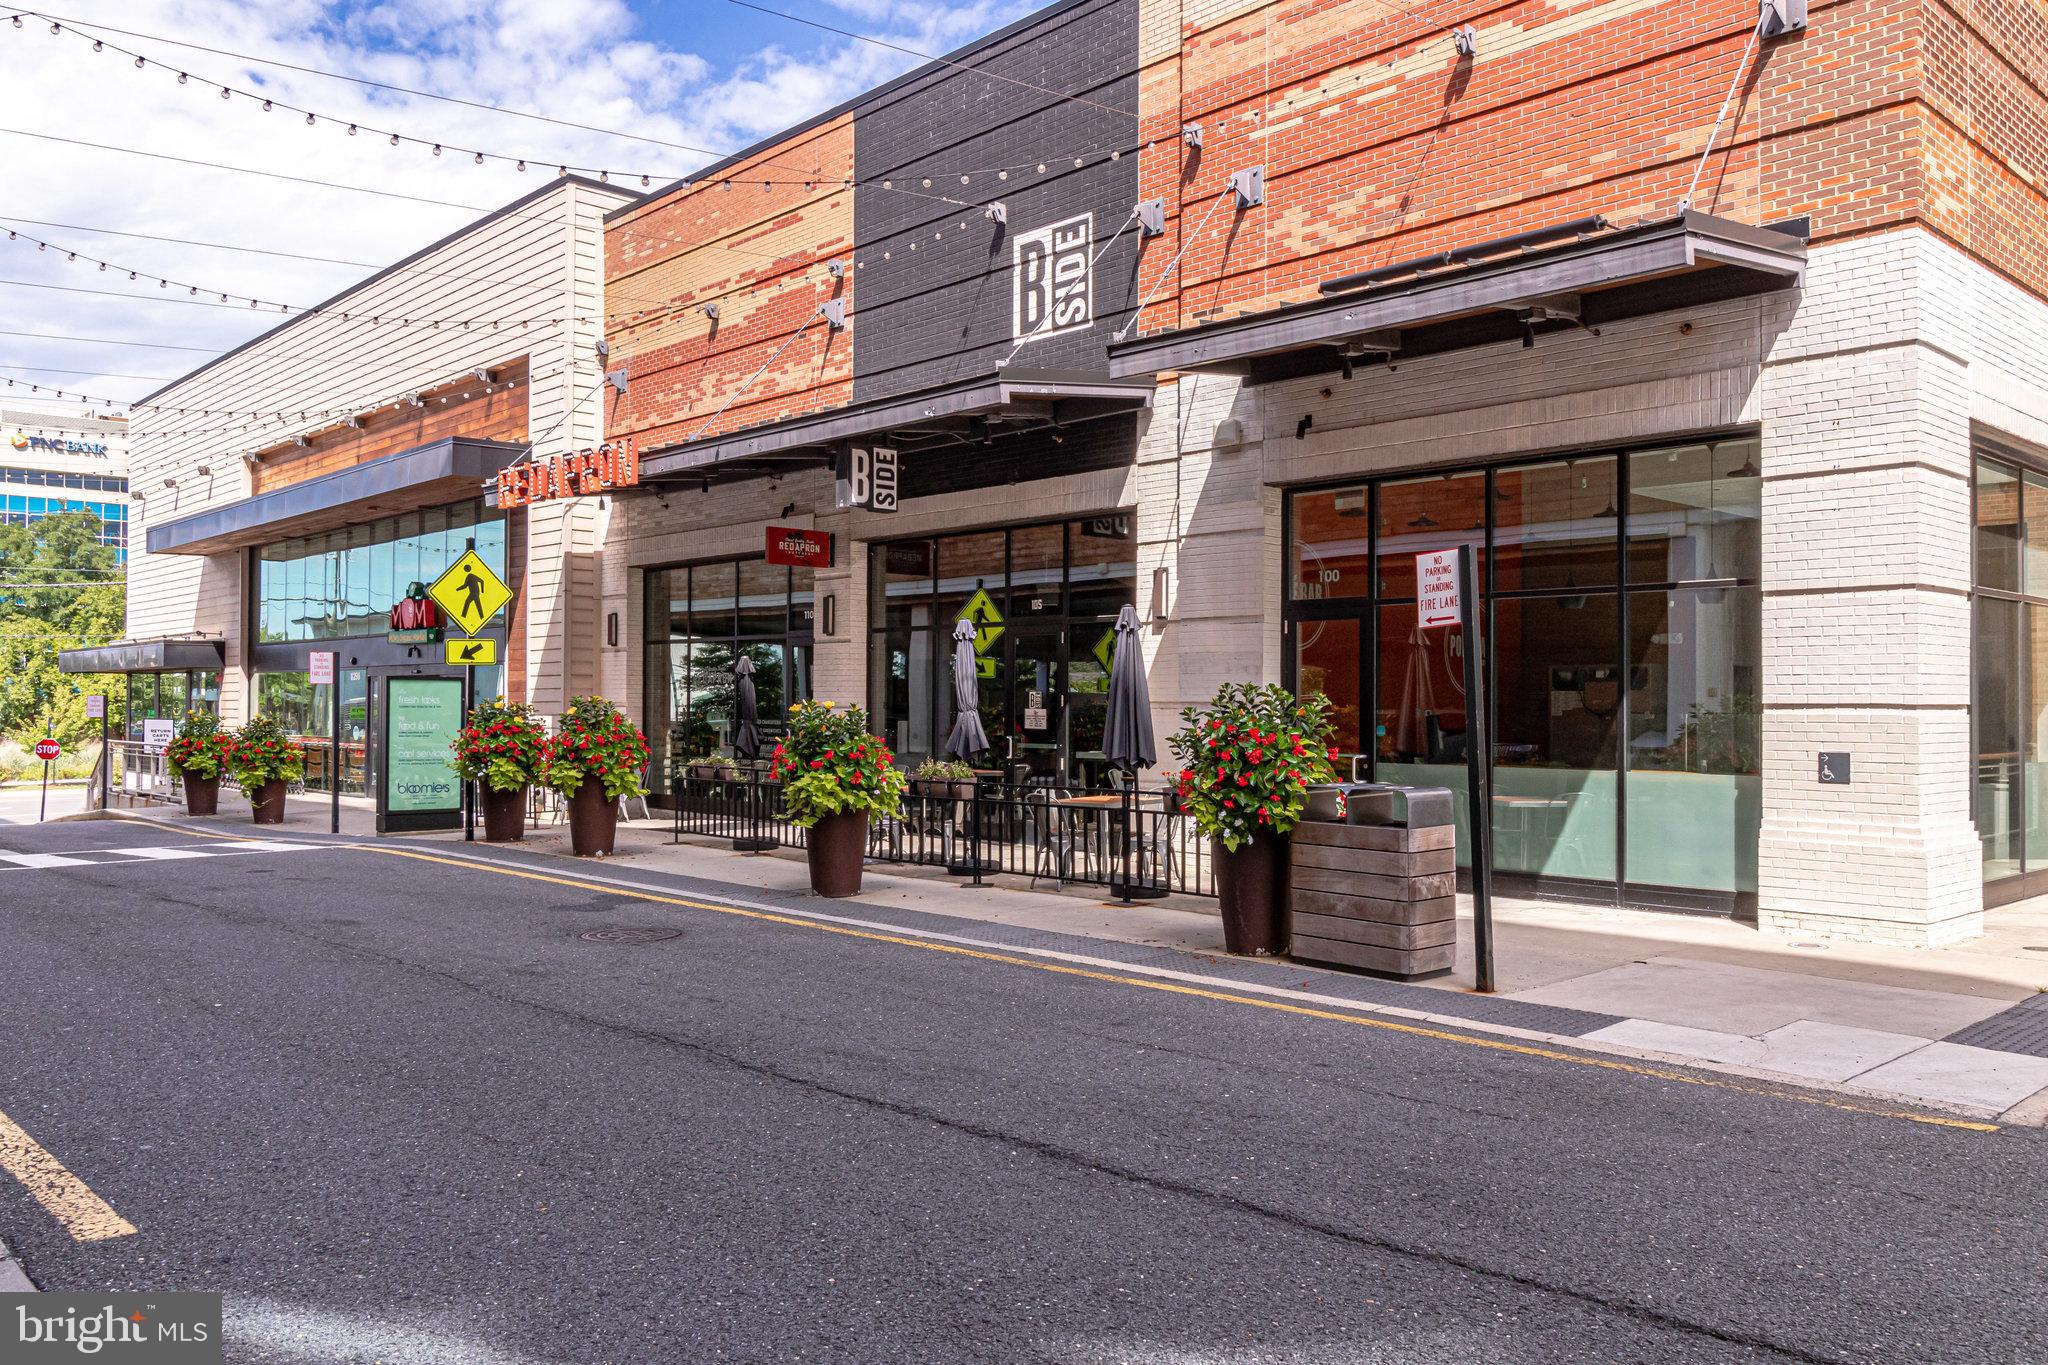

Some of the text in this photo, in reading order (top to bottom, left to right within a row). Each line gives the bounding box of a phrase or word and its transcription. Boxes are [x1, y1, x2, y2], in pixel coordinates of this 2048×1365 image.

[1020, 224, 1086, 336] B SIDE
[29, 436, 107, 454] PNC BANK
[852, 448, 895, 507] B SIDE
[779, 541, 820, 553] REDAPRON
[1433, 556, 1442, 565] NO
[1319, 569, 1340, 582] 100
[1425, 565, 1451, 577] PARKING
[1425, 581, 1453, 594] STANDING
[1420, 595, 1458, 611] FIRE LANE
[399, 695, 418, 704] fresh
[426, 721, 439, 730] fun
[36, 745, 59, 754] STOP
